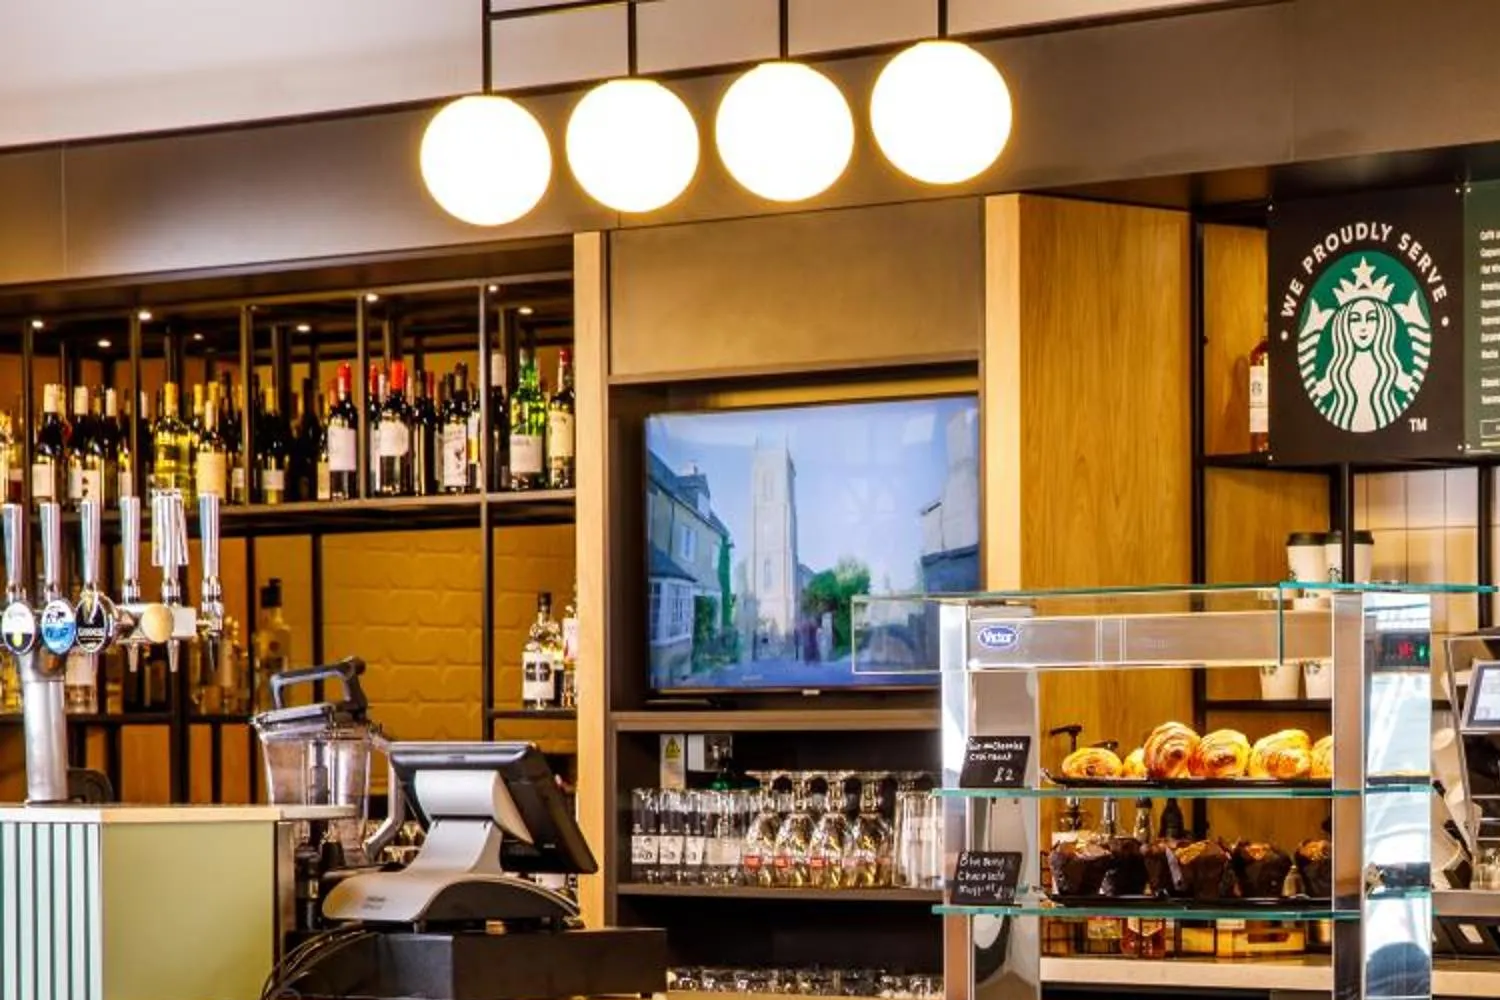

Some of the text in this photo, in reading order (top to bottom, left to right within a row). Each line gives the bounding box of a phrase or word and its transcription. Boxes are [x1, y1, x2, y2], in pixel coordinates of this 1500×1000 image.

[1280, 221, 1447, 317] WE PROUDLY SERVE
